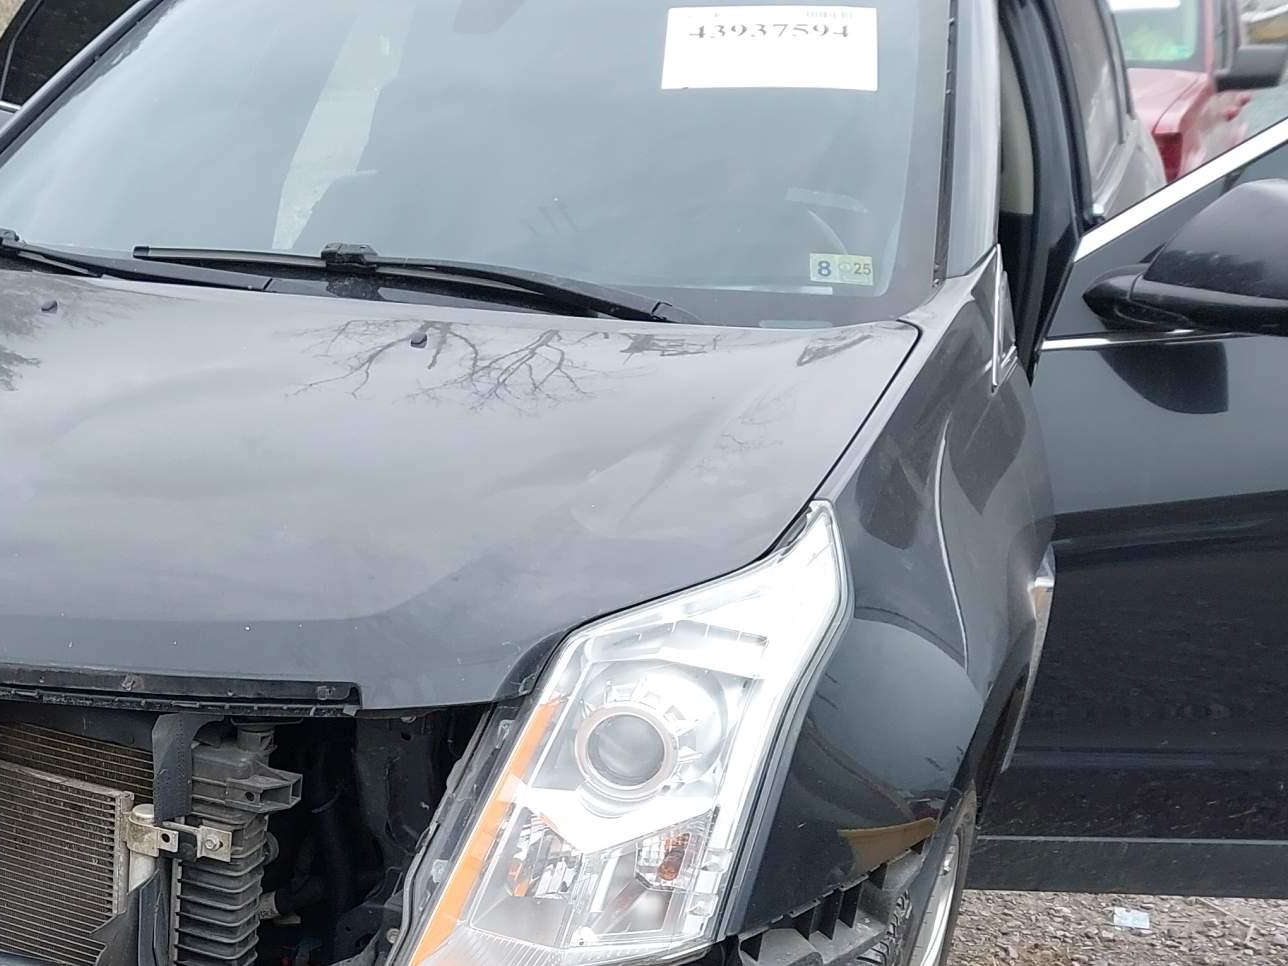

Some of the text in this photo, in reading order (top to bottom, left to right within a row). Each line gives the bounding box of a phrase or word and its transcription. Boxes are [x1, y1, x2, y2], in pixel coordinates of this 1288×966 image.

[688, 23, 850, 39] 43937594
[817, 260, 872, 277] 8 25
